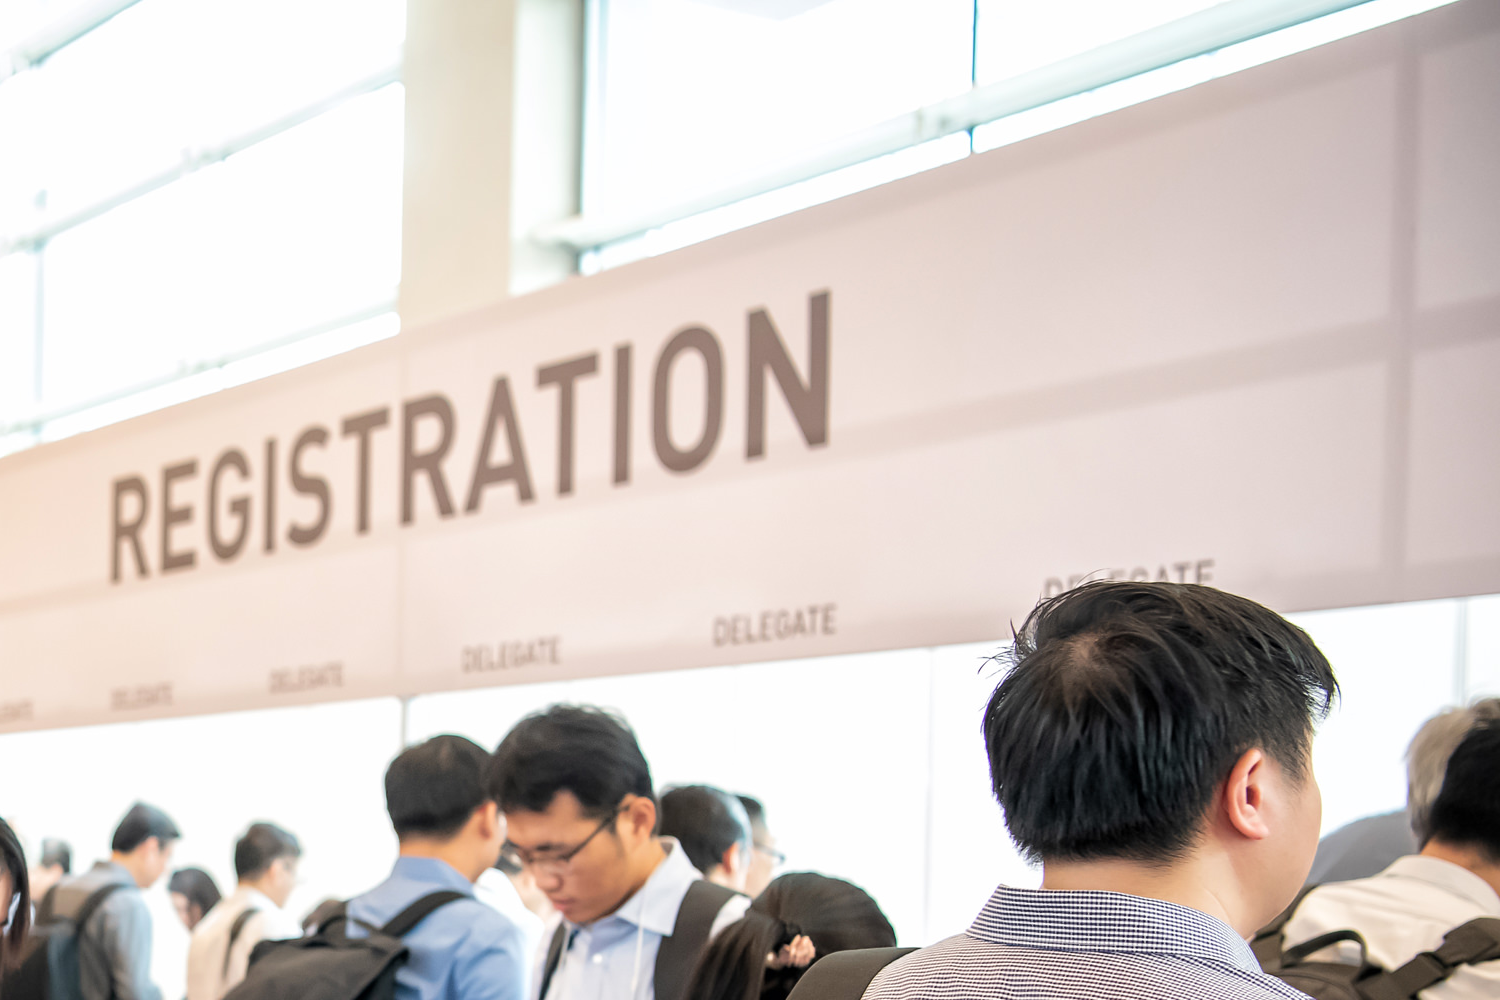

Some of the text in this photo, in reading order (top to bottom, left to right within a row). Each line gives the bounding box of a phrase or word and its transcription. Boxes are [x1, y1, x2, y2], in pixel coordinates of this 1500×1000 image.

[110, 287, 832, 586] REGISTRATION
[1043, 557, 1217, 601] DATE
[711, 602, 839, 648] DELEGATE
[461, 634, 562, 674] DELEGATE
